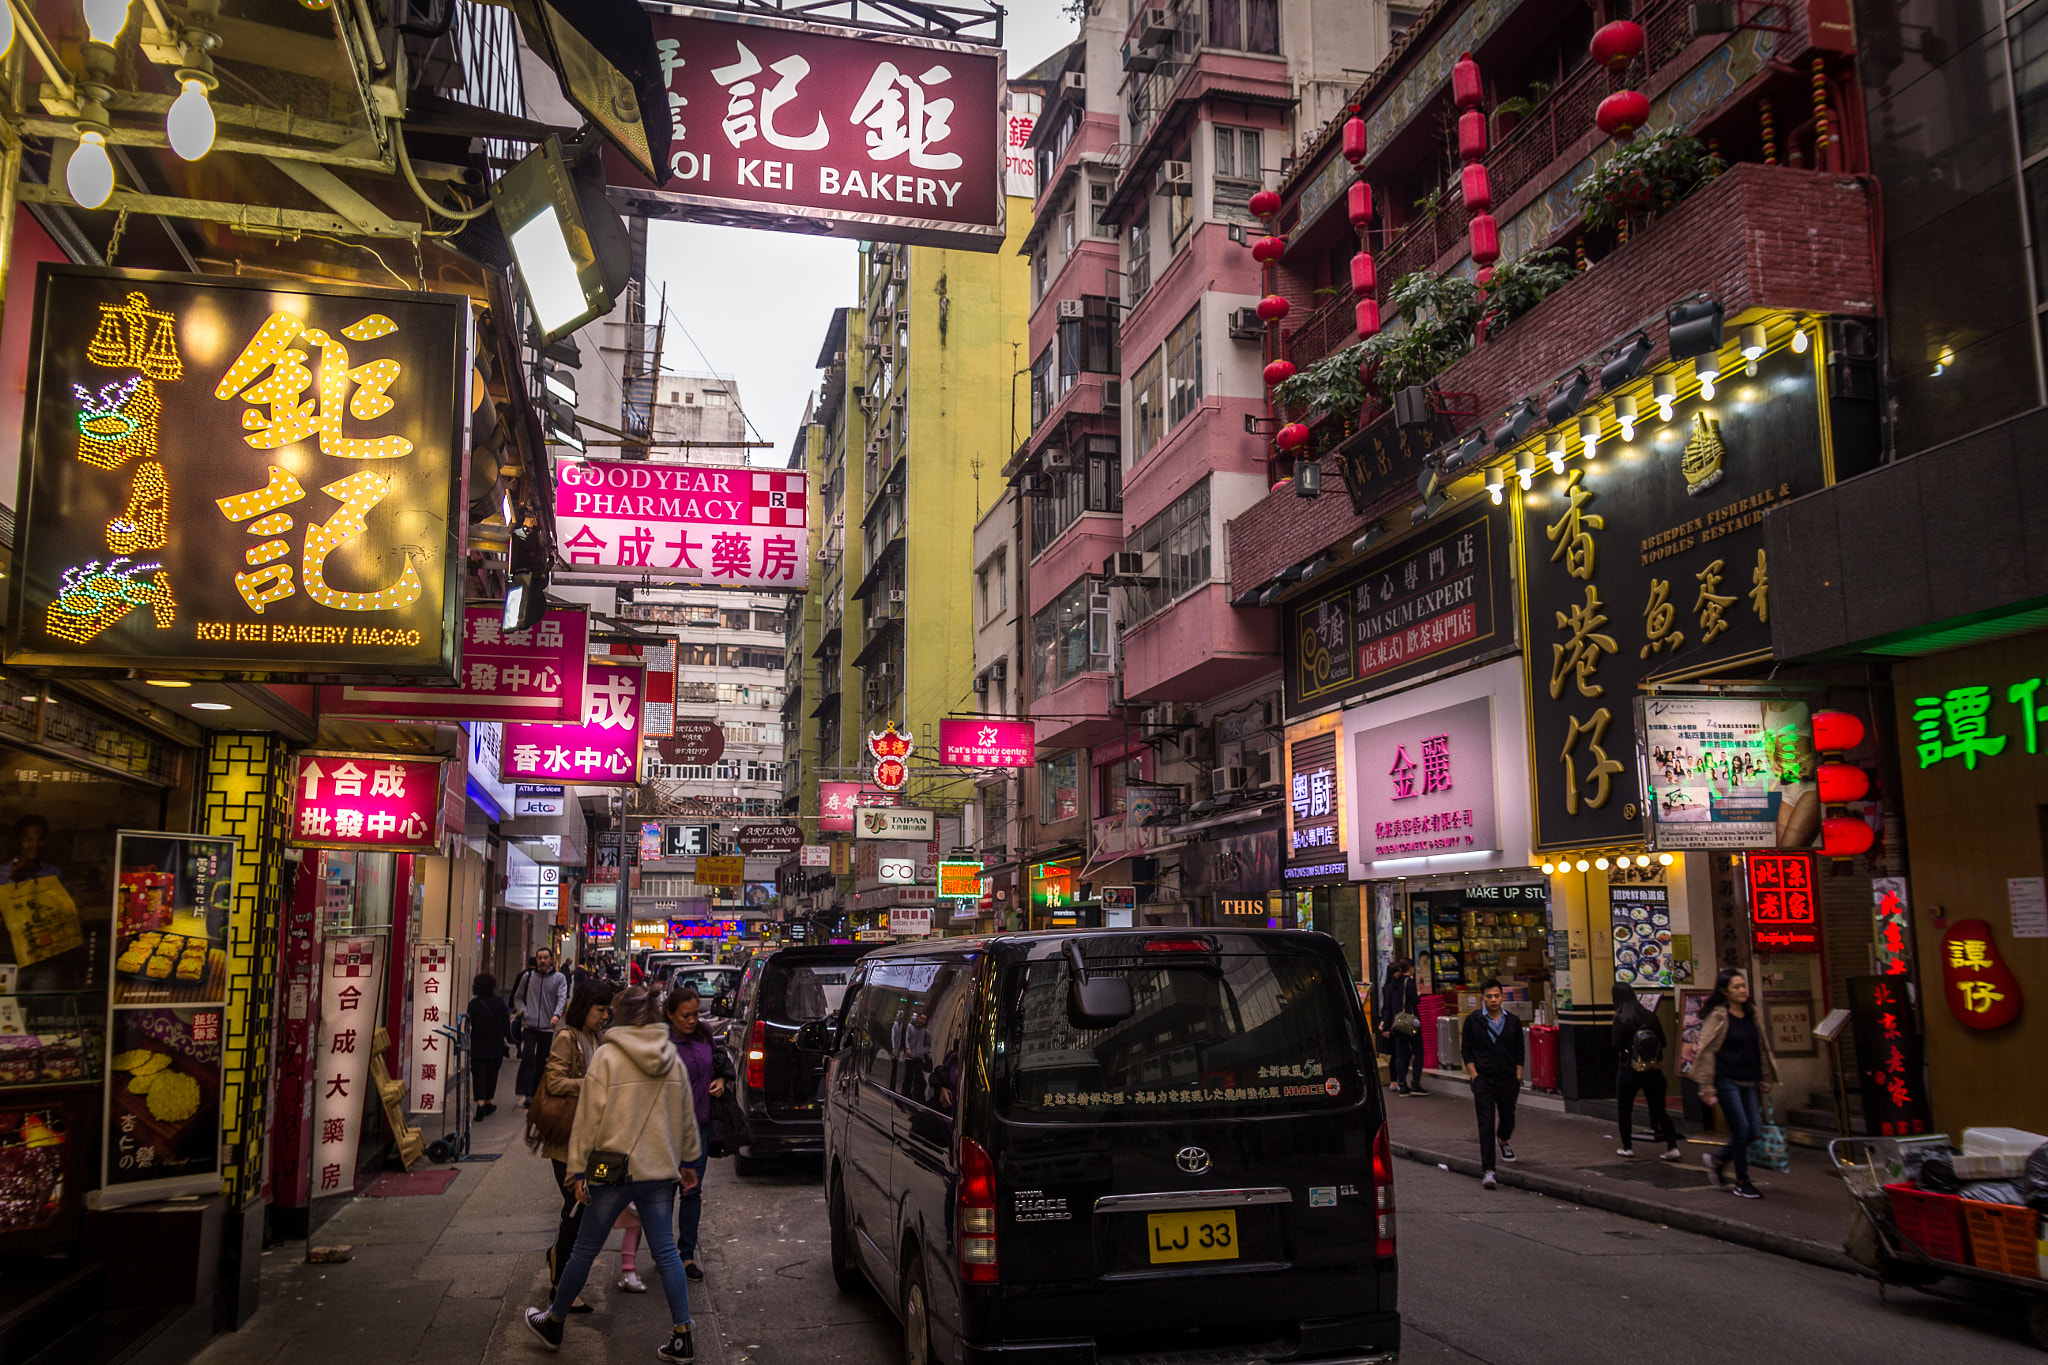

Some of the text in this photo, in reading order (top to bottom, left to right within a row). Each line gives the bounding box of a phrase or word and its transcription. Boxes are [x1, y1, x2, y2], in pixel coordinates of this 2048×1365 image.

[671, 151, 963, 207] OI KEI BAKERY
[1007, 157, 1034, 176] PTICS
[215, 311, 421, 613] 鉅記
[561, 463, 732, 493] GOODYEAR
[574, 492, 743, 520] PHARMACY
[1641, 516, 1703, 552] ABERDEEN
[1708, 489, 1775, 525] FISHBALL
[564, 524, 799, 580] 合成大藥房
[1641, 536, 1695, 566] NOODLES
[1357, 533, 1475, 610] 點心專門店
[1358, 575, 1475, 642] DIM SUM EXPERT
[197, 622, 421, 647] KOI KEI BAKERY MACAO
[1316, 600, 1345, 650] 粵廚
[1546, 469, 1625, 816] 香港仔
[461, 663, 563, 693] 發中心
[513, 744, 632, 775] 香水中心
[948, 746, 1027, 756] Kat's beauty centre
[332, 763, 406, 798] 合成
[880, 763, 901, 785] 押
[1389, 732, 1452, 801] 金麗
[1291, 766, 1332, 819] 粵廚
[301, 807, 428, 839] 批發中心
[674, 826, 700, 849] JE
[746, 827, 796, 836] ARTLAND
[740, 837, 801, 845] BEAUTY CENTRE
[1434, 837, 1459, 848] BEAUTY
[1325, 863, 1346, 874] EXPERT
[1756, 860, 1806, 888] 北京
[1221, 900, 1264, 915] THIS
[1466, 888, 1499, 899] MAKE
[1504, 888, 1520, 898] UP
[1760, 892, 1809, 919] 老家
[670, 924, 722, 937] Canon
[1757, 932, 1815, 945] Beijing home
[1948, 940, 2004, 1013] 譚仔
[420, 977, 440, 1110] 合成大藥房
[1780, 1034, 1803, 1043] INLET
[322, 985, 362, 1190] 合成大藥房
[1283, 1084, 1324, 1098] HIACE
[1015, 1198, 1067, 1212] HIACE
[1155, 1223, 1232, 1252] LJ 33
